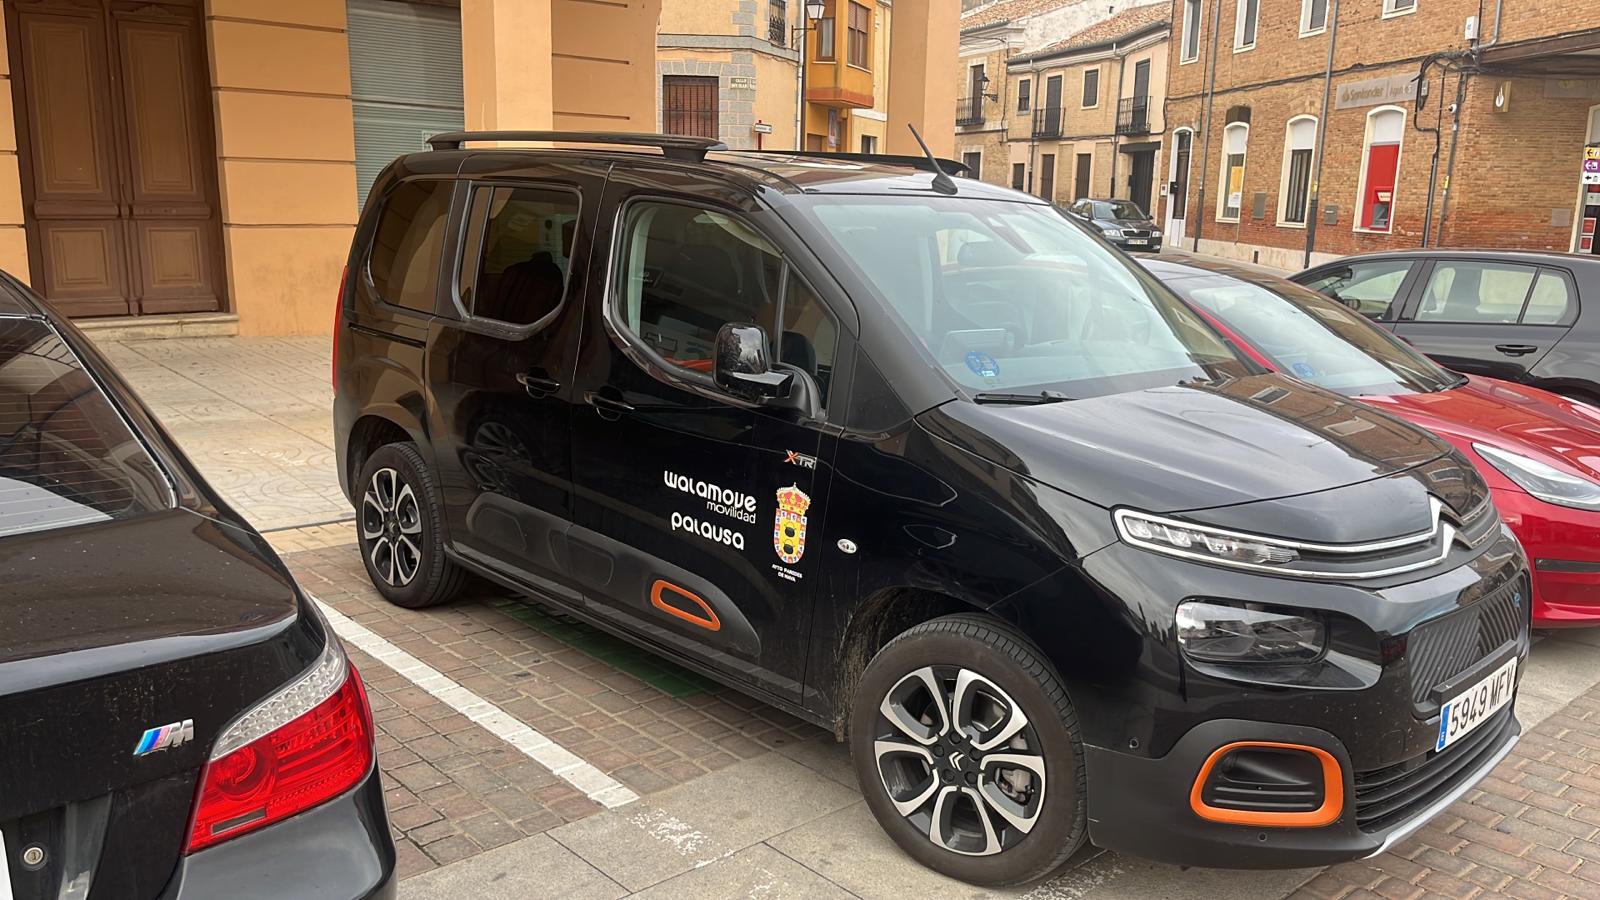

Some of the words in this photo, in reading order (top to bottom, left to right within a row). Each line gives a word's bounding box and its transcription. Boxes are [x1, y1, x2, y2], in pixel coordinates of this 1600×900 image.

[1350, 85, 1384, 101] Santander
[783, 449, 817, 470] XTR
[663, 470, 757, 512] walamove
[706, 501, 757, 524] movilidad
[671, 511, 745, 550] palausa
[1449, 685, 1488, 737] 5949
[1489, 664, 1515, 710] MFV
